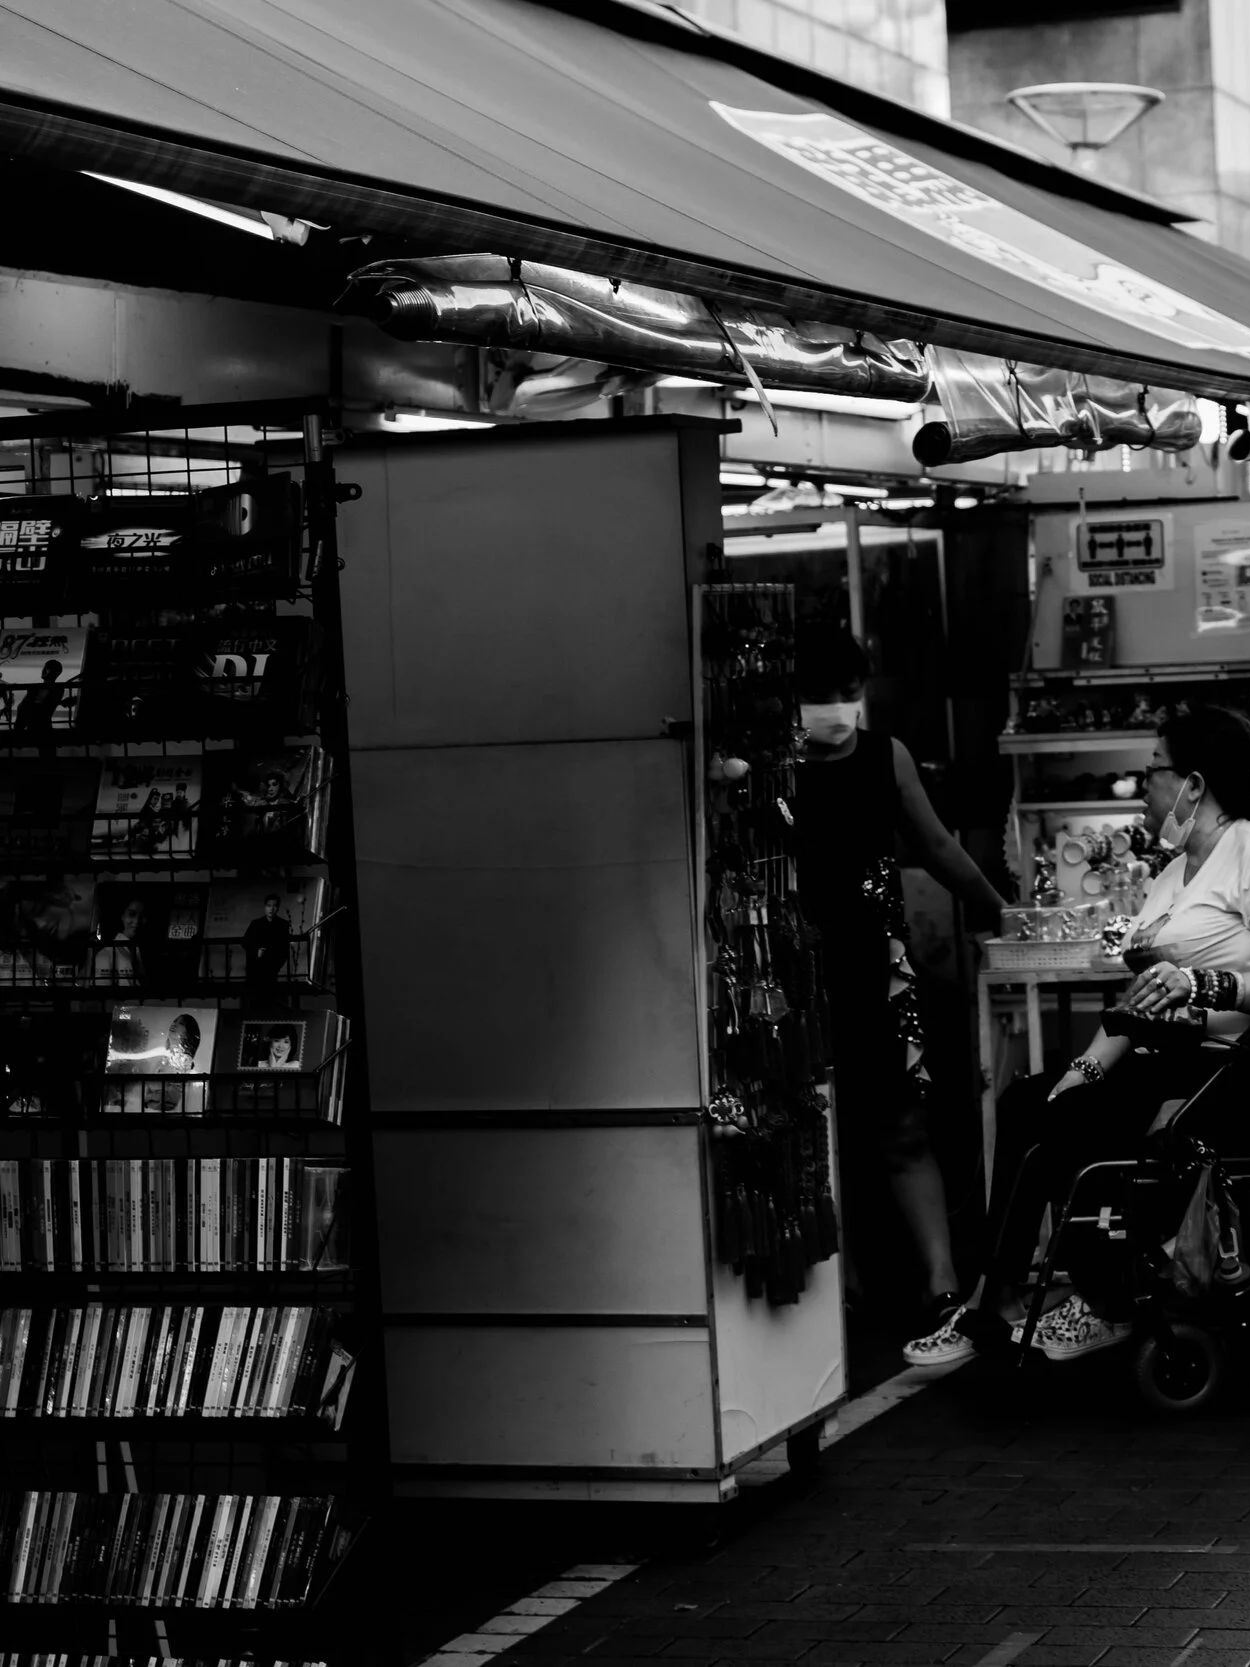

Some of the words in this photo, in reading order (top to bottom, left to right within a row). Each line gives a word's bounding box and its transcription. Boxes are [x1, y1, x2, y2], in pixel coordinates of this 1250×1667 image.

[107, 533, 161, 548] 夜之光
[1114, 570, 1156, 586] DISTANCING
